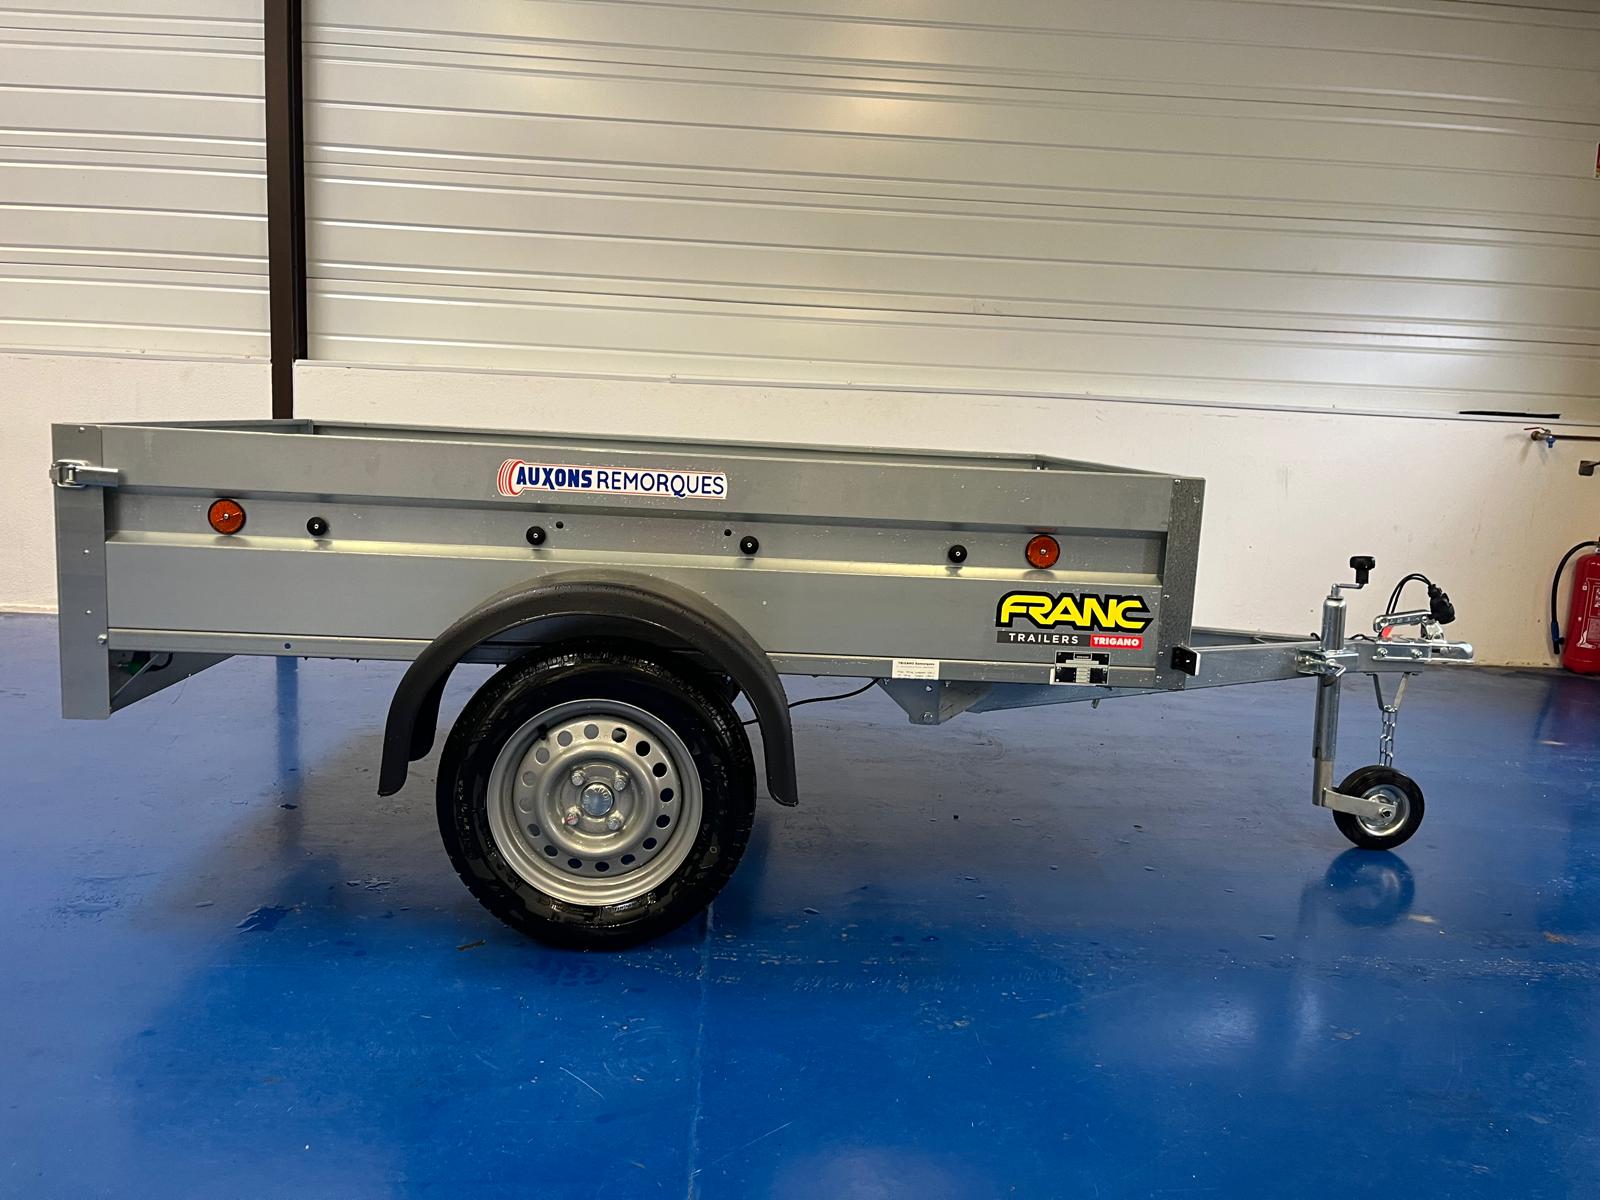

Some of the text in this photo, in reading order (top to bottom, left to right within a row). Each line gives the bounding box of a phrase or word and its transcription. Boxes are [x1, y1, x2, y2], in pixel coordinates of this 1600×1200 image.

[516, 466, 724, 497] AUXONS REMORQUES
[1000, 593, 1147, 630] FRANC
[1009, 633, 1140, 646] TRAILERS TRIGANO
